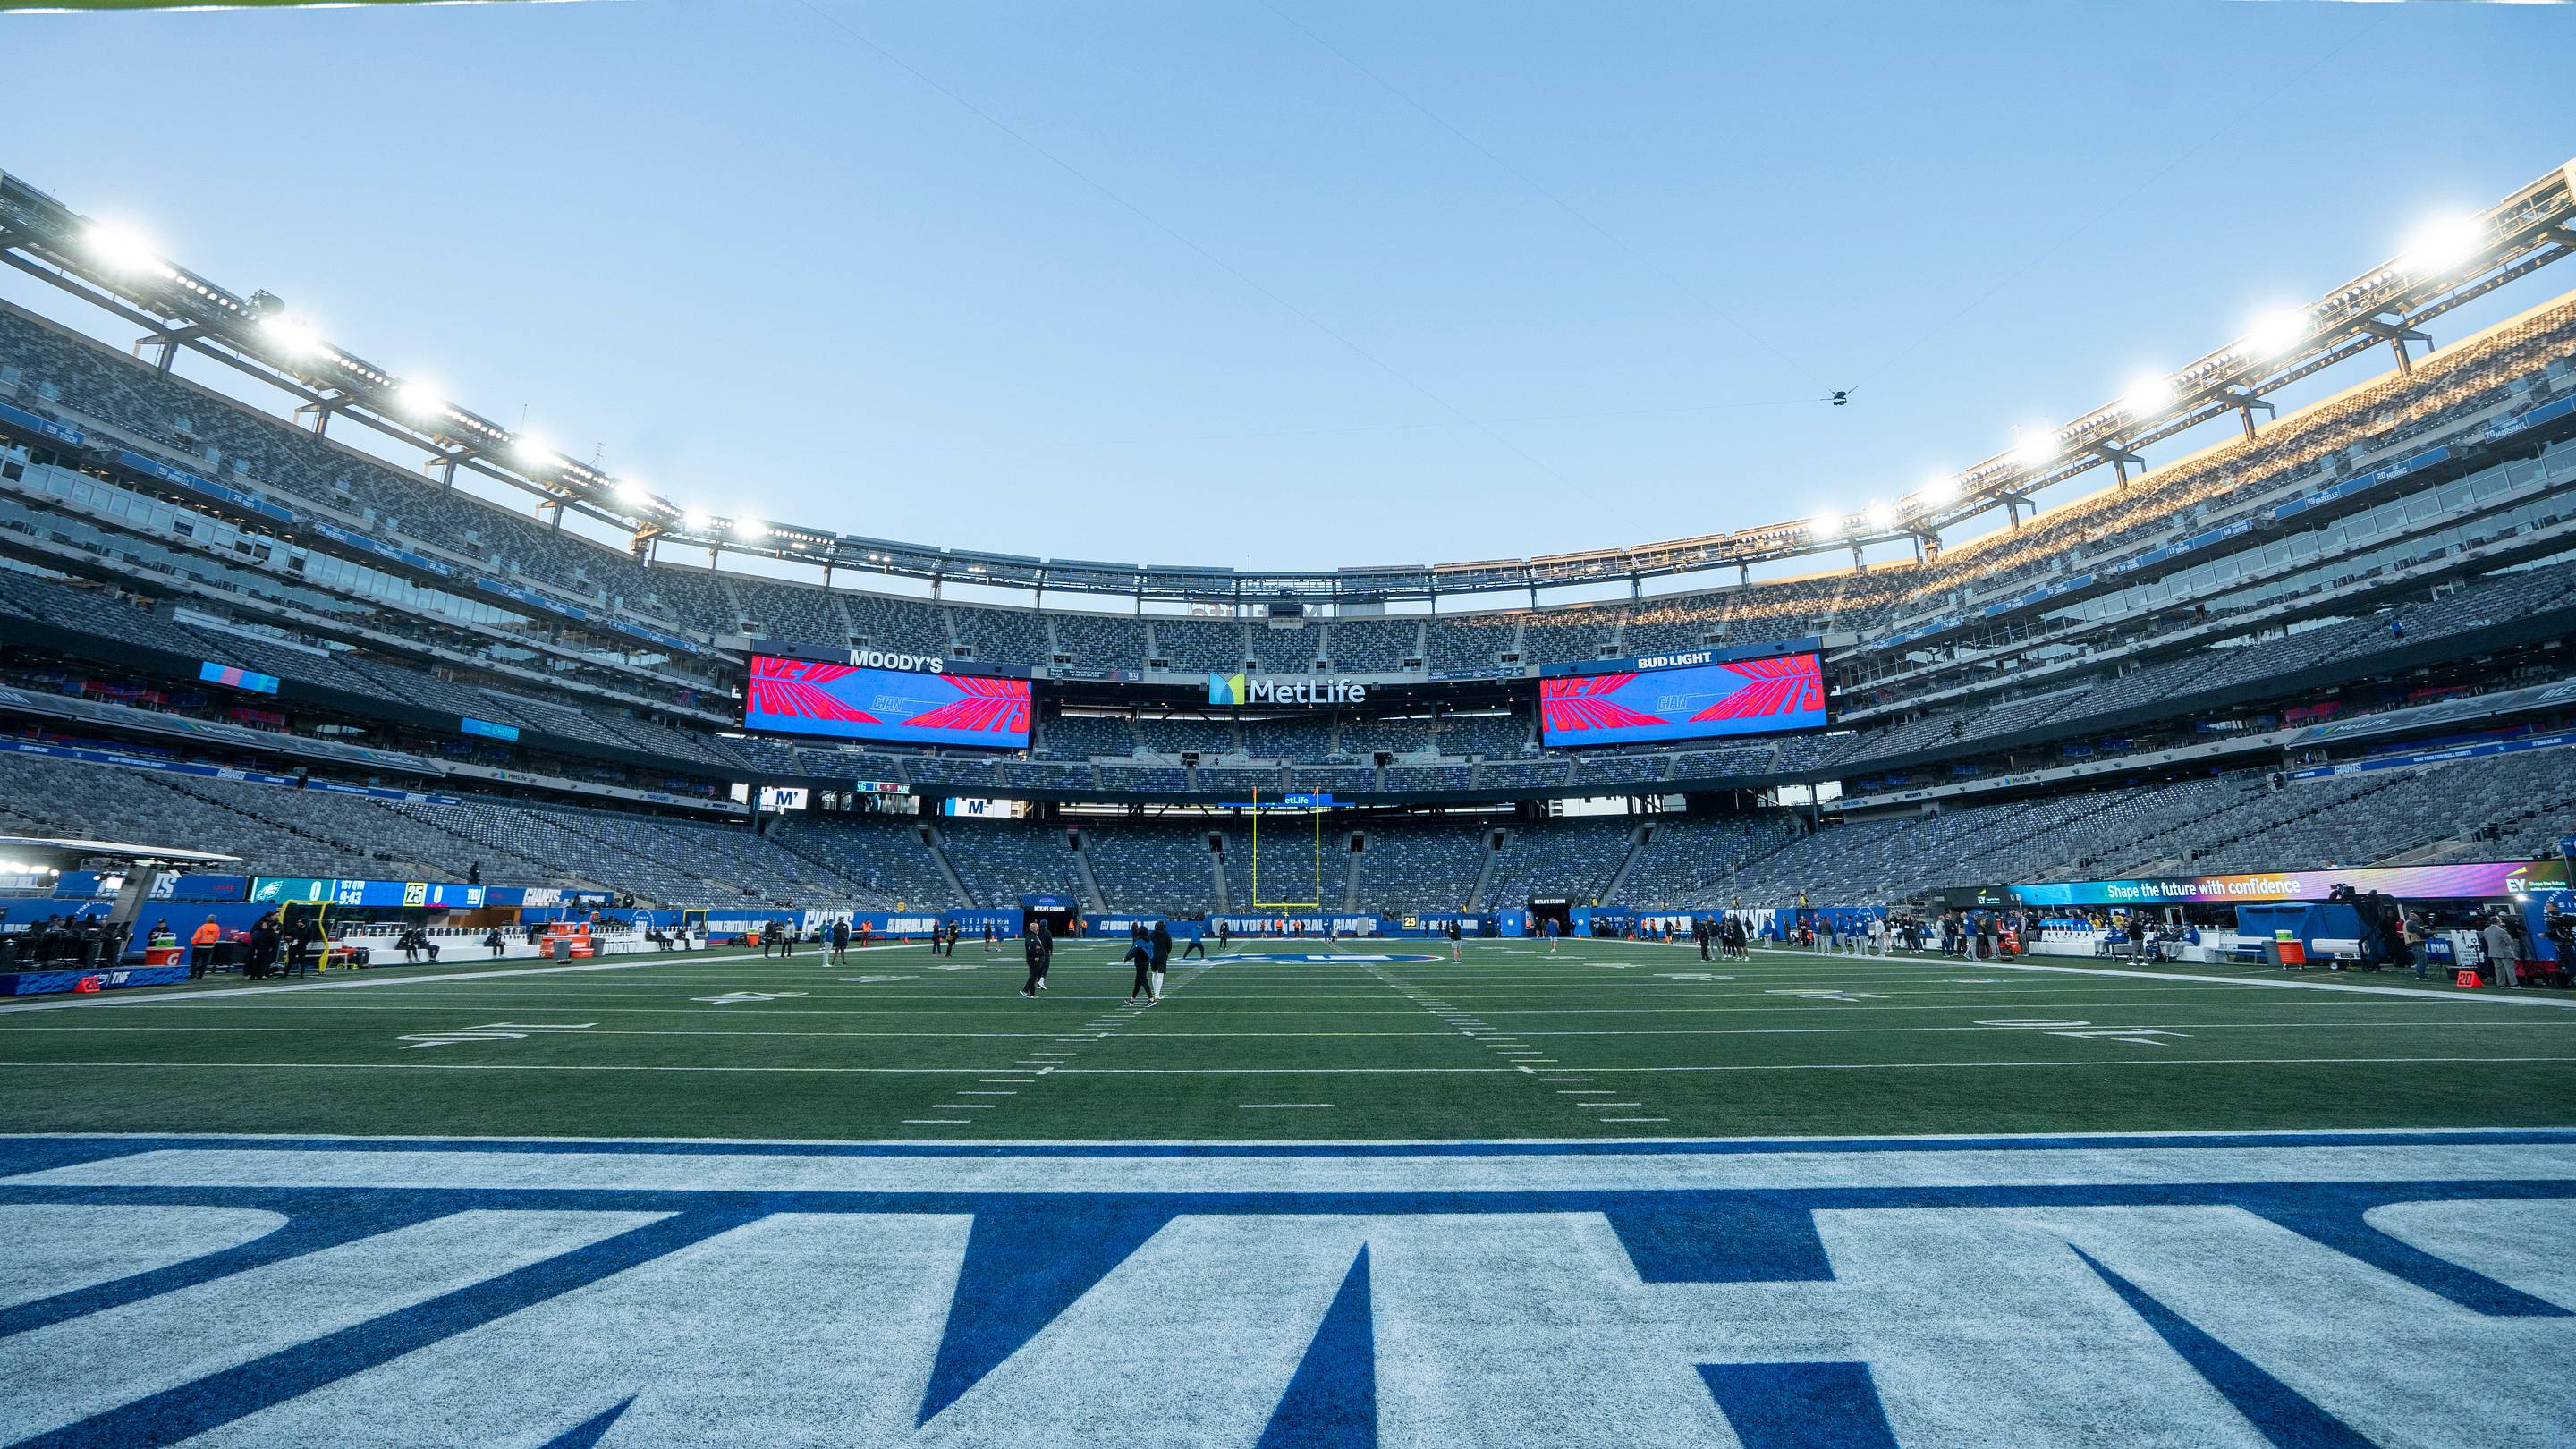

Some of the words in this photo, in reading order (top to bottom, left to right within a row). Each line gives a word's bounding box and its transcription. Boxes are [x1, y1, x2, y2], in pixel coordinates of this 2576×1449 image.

[2496, 422, 2527, 438] MARSHALL
[850, 650, 944, 674] MOODY'S
[1638, 657, 1671, 669] BUD
[1672, 652, 1712, 667] LIGHT
[1250, 679, 1366, 704] MetLife
[2334, 763, 2361, 775] GIANTS
[309, 881, 322, 902] 0
[341, 880, 352, 889] 1ST
[2107, 885, 2139, 900] Shape
[2140, 882, 2159, 897] the
[2161, 881, 2197, 896] future
[2199, 879, 2225, 894] with
[2228, 877, 2301, 894] confidence
[2505, 878, 2526, 893] EY
[339, 891, 363, 905] 9:43
[406, 886, 423, 904] 25
[433, 886, 443, 904] 0
[522, 887, 562, 905] GIANTS
[1977, 896, 1986, 904] EY
[1403, 917, 1416, 927] 25
[167, 953, 179, 966] G
[111, 971, 130, 984] TNF
[2458, 972, 2473, 986] 20
